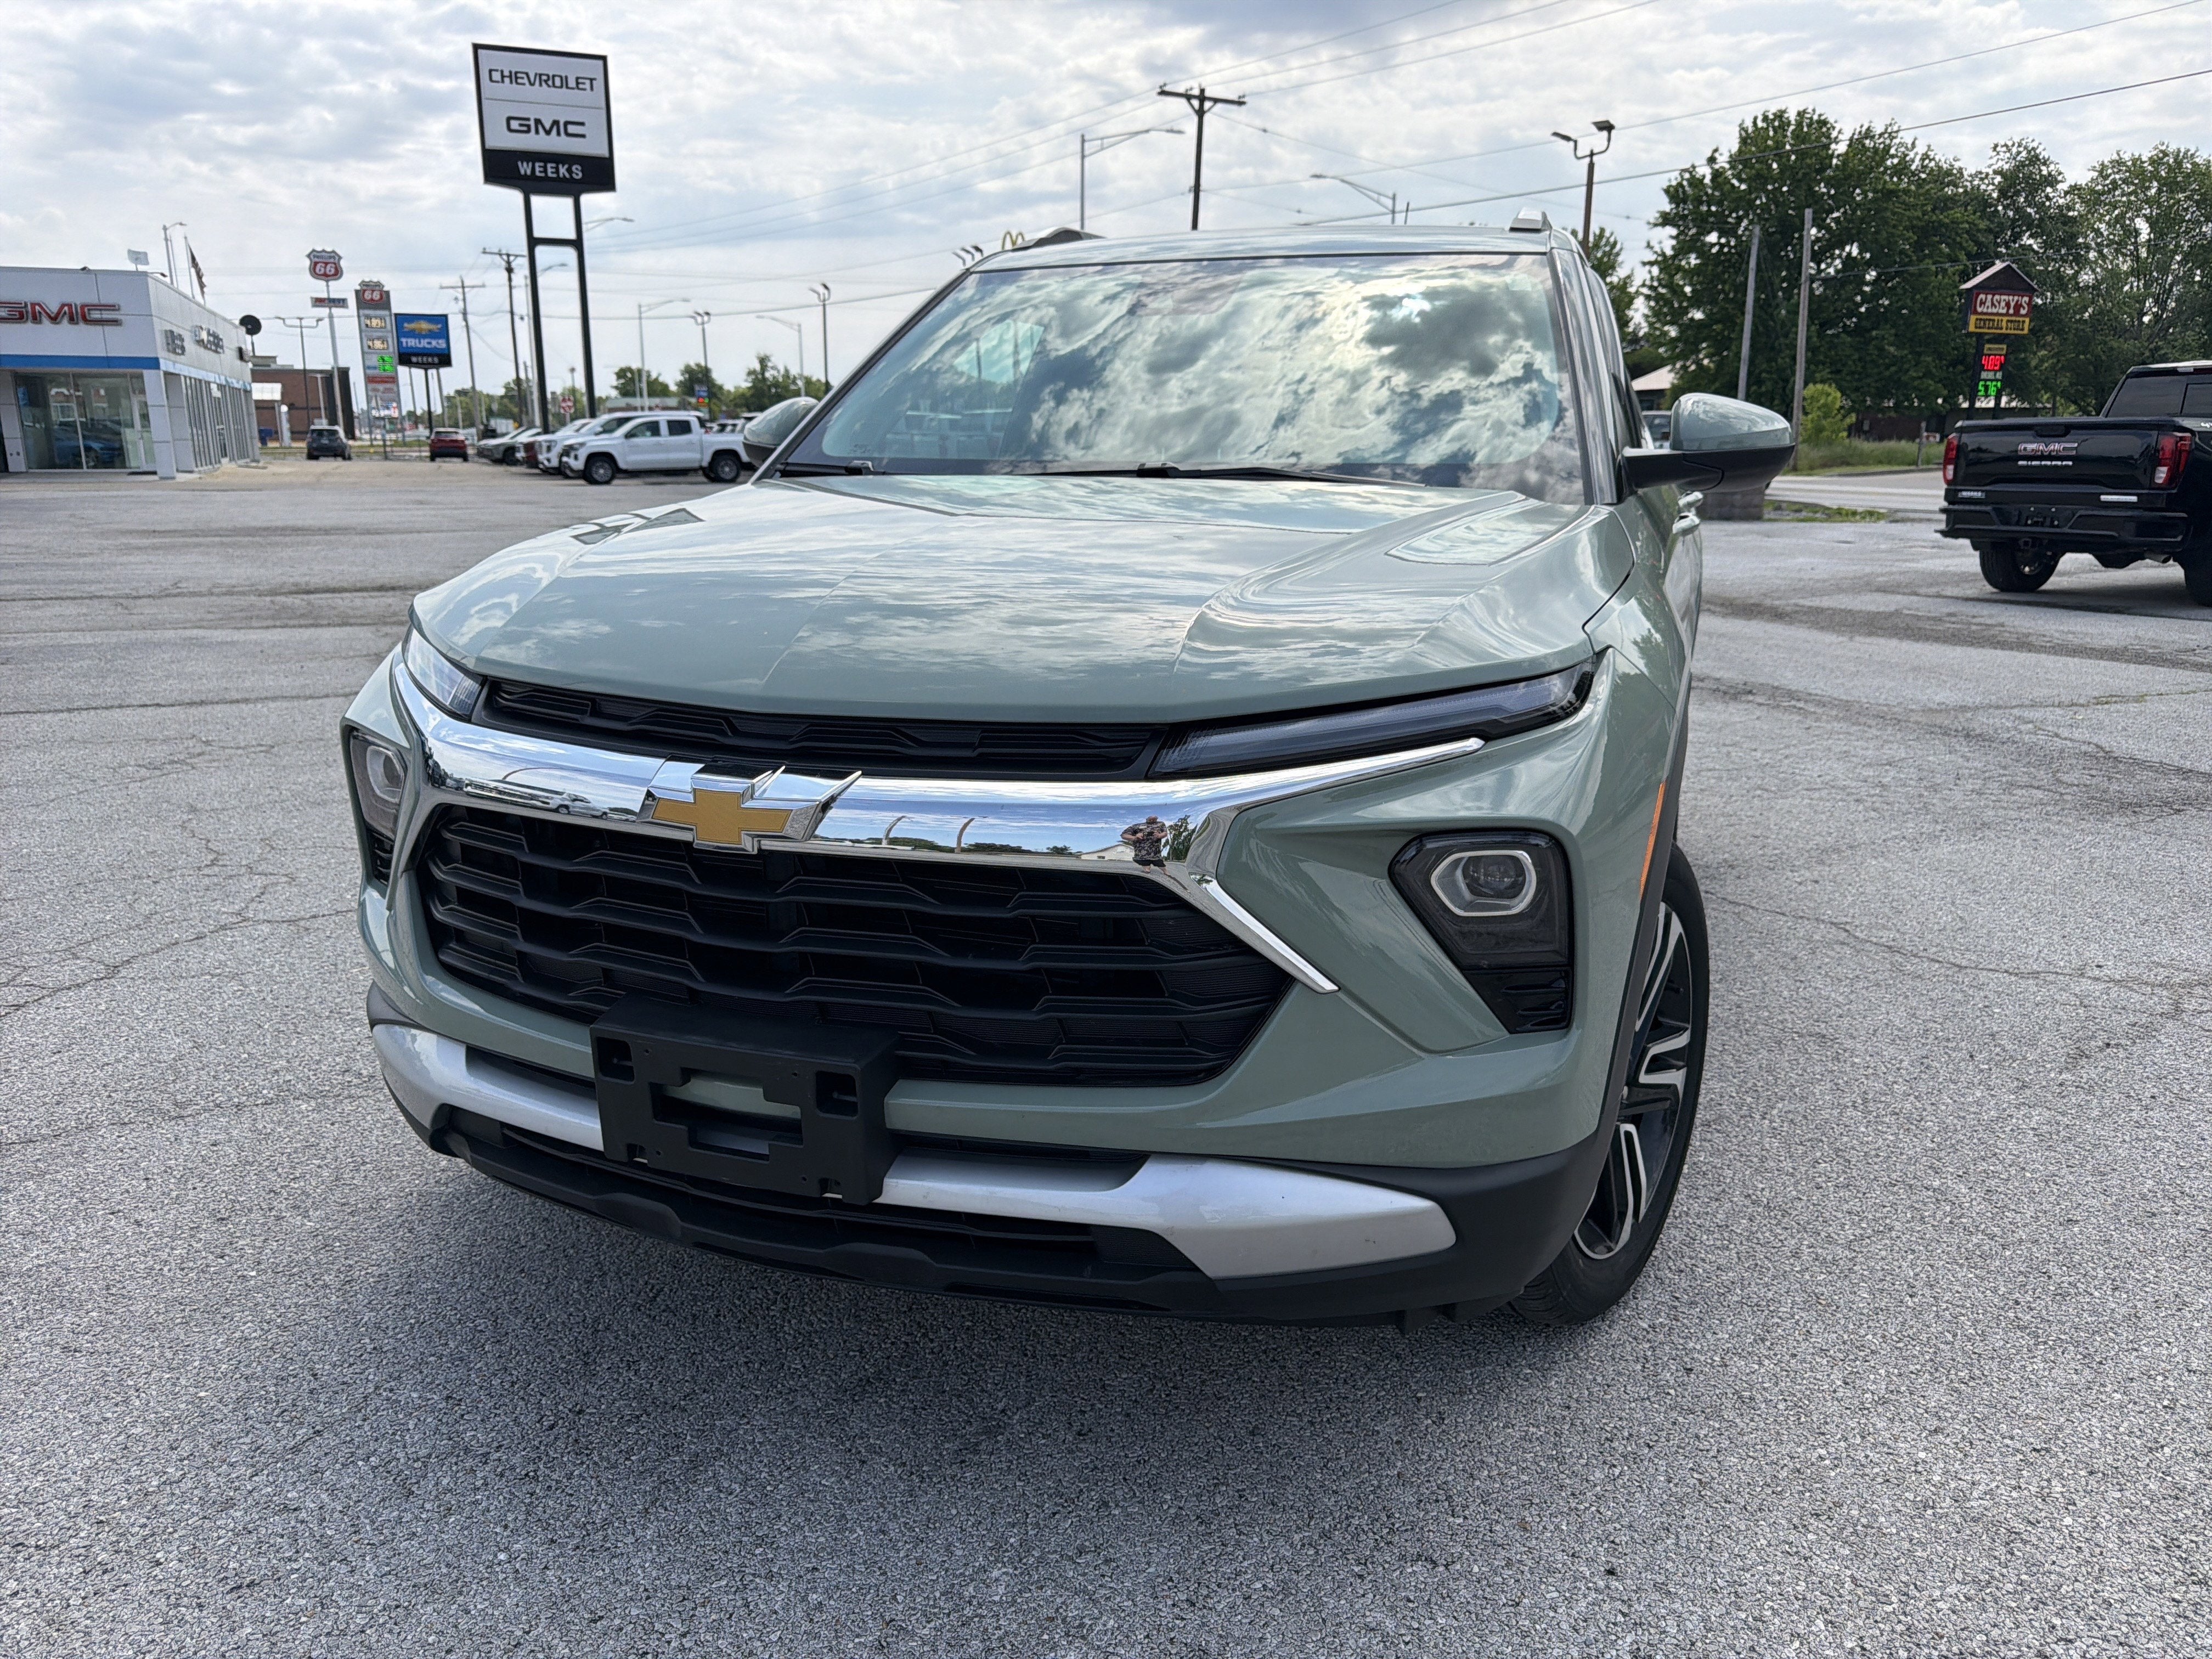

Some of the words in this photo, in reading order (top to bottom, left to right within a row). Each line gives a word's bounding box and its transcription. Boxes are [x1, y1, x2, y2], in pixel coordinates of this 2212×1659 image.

[488, 68, 597, 92] CHEVROLET
[505, 115, 586, 139] GMC
[517, 160, 583, 180] WEEKS
[315, 262, 336, 275] 66
[364, 290, 380, 301] 66
[1976, 294, 2029, 315] CASEY'S
[0, 301, 122, 326] GMC
[1974, 318, 2004, 330] GENERAL
[2005, 319, 2026, 331] STORE
[400, 337, 447, 349] TRUCKS
[410, 356, 439, 364] WEEKS
[2017, 442, 2078, 455] GMC
